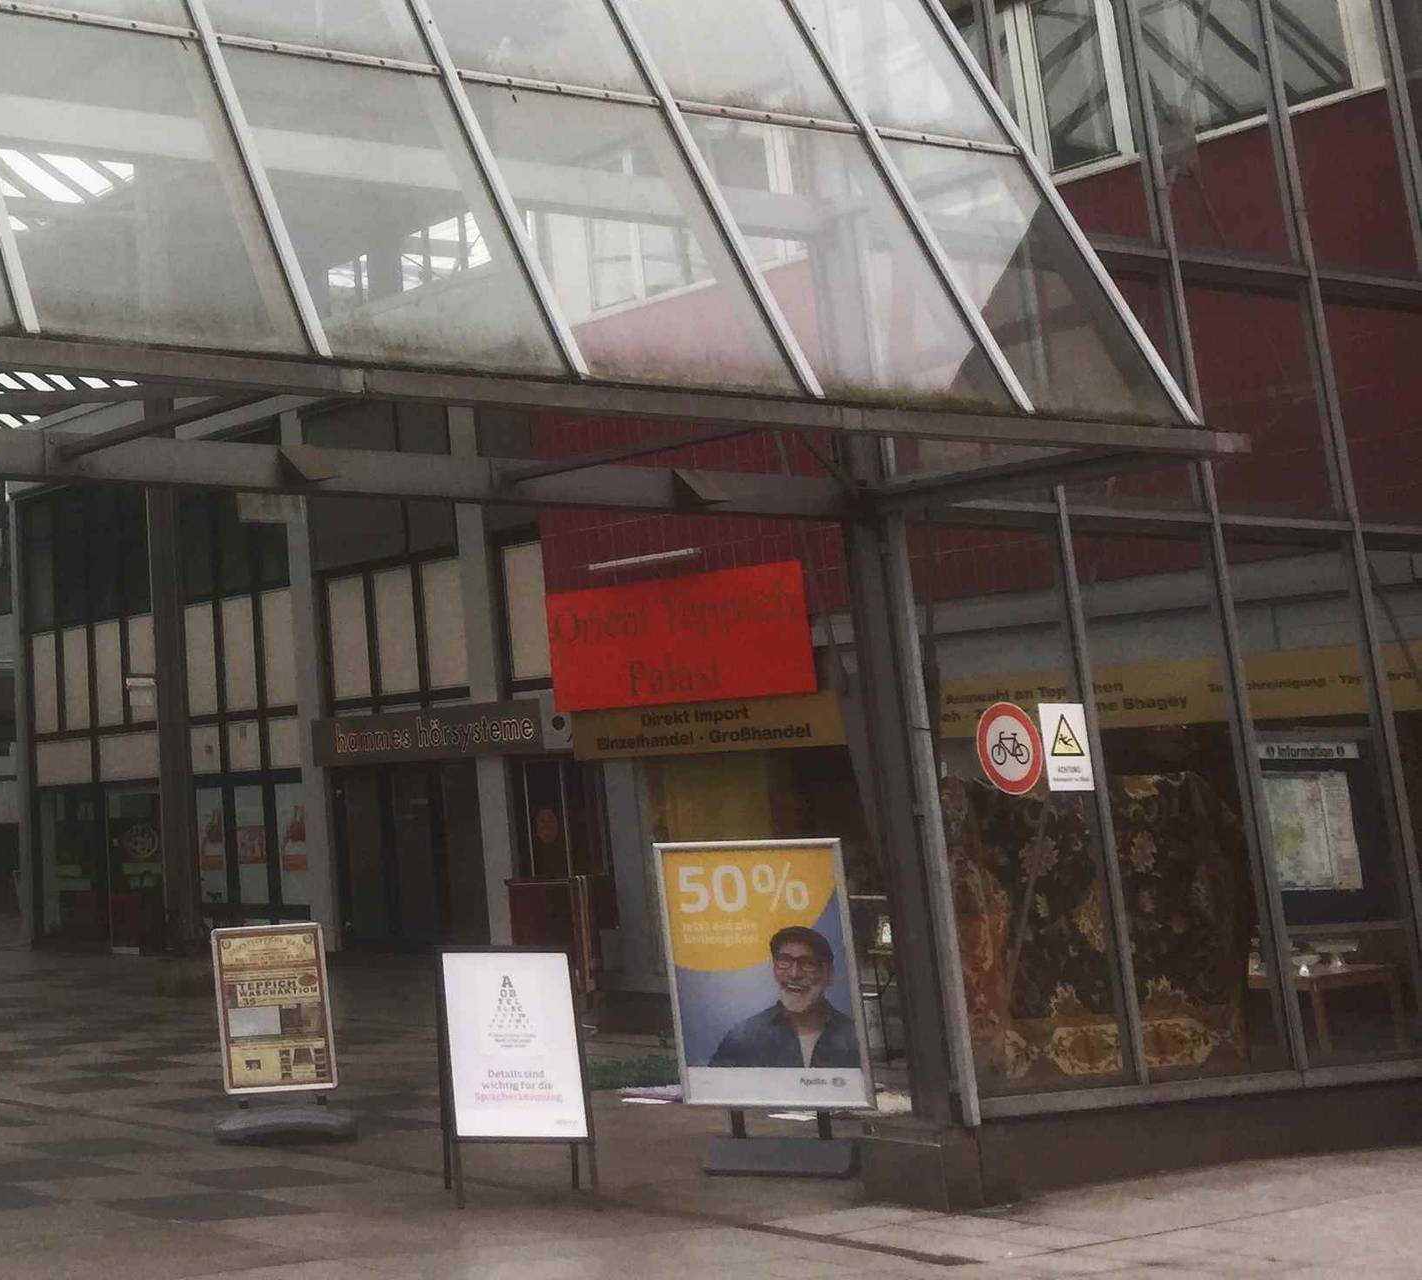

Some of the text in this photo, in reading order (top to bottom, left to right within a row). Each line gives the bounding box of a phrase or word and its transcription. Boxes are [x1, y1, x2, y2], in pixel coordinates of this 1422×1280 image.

[1015, 689, 1034, 700] an
[641, 705, 751, 728] Direkt Import
[335, 715, 535, 753] hammes hörsysteme
[596, 730, 694, 751] Einzelhandel
[709, 723, 812, 744] Großhandel
[1277, 744, 1334, 758] Information
[677, 861, 809, 914] 50%
[237, 979, 296, 992] TEPPICH
[501, 975, 513, 988] A
[239, 986, 318, 997] WASCHAKTION
